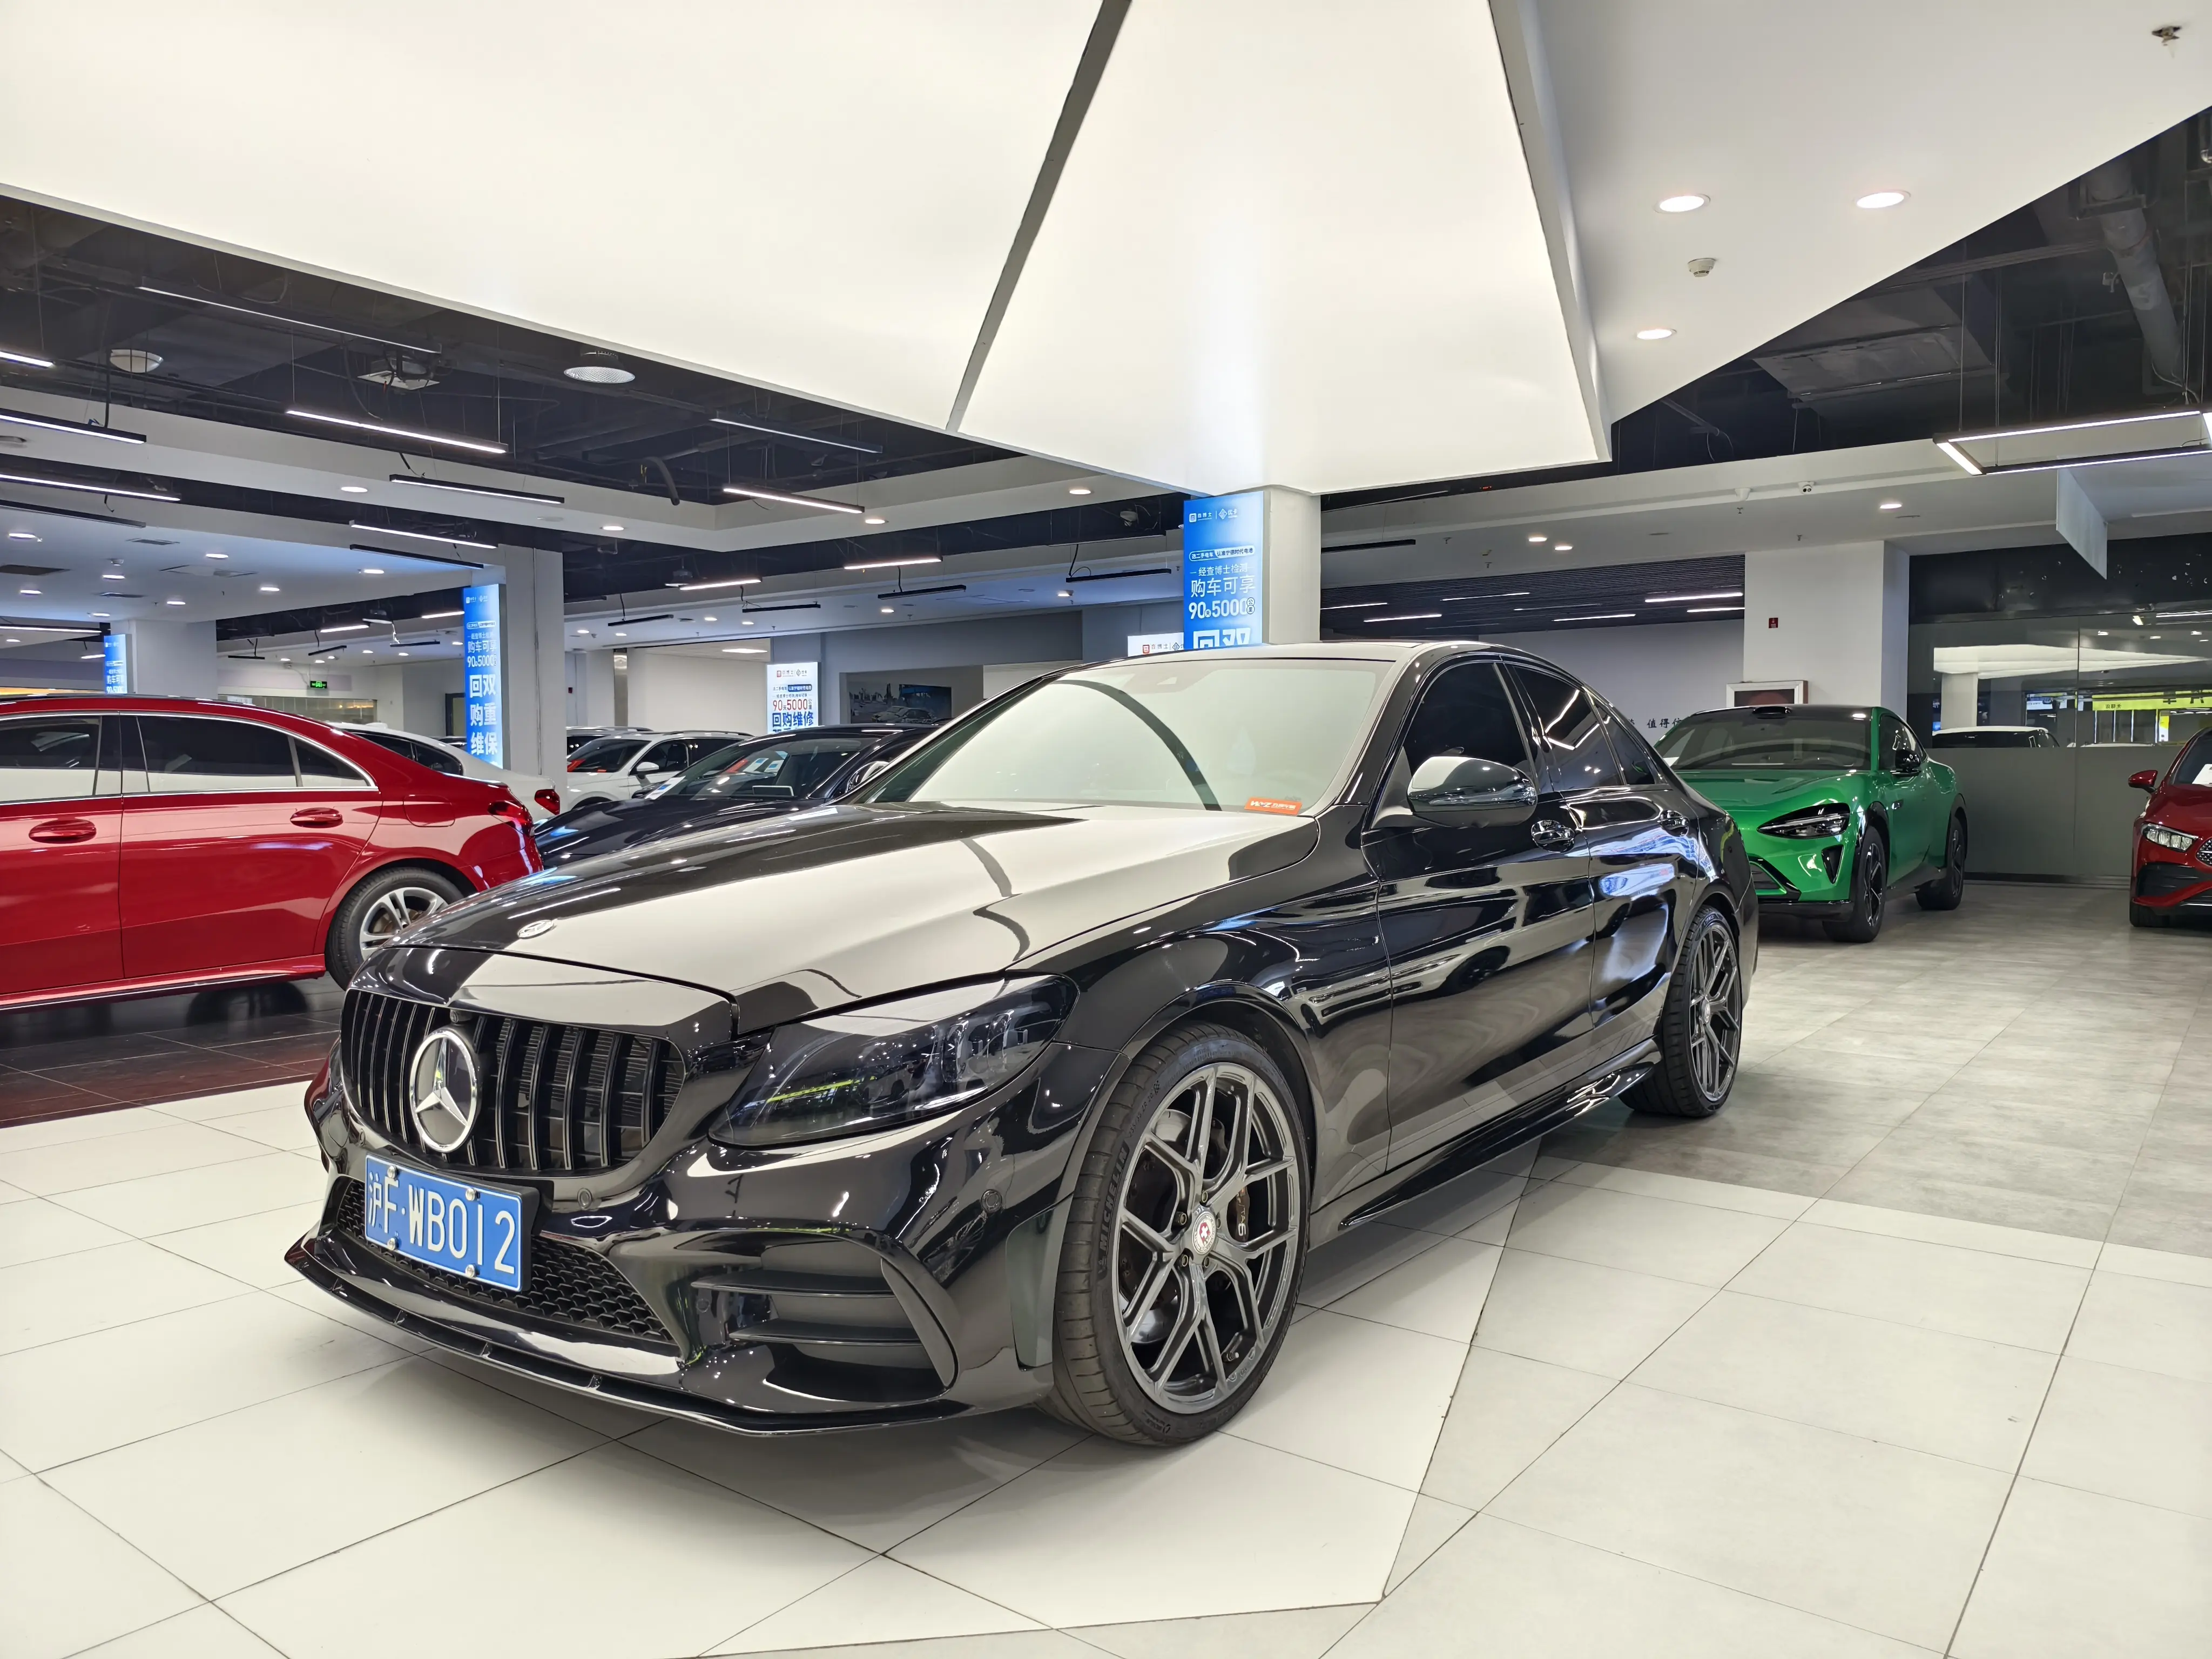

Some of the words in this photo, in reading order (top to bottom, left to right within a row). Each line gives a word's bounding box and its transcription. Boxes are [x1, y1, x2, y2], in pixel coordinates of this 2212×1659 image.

[1217, 548, 1253, 557] 认准宁德时代电池
[1198, 563, 1247, 576] 经查博士检测
[1191, 575, 1256, 598] 购车可享
[772, 711, 814, 728] 回购维修
[1099, 1146, 1128, 1252] MICHELIN
